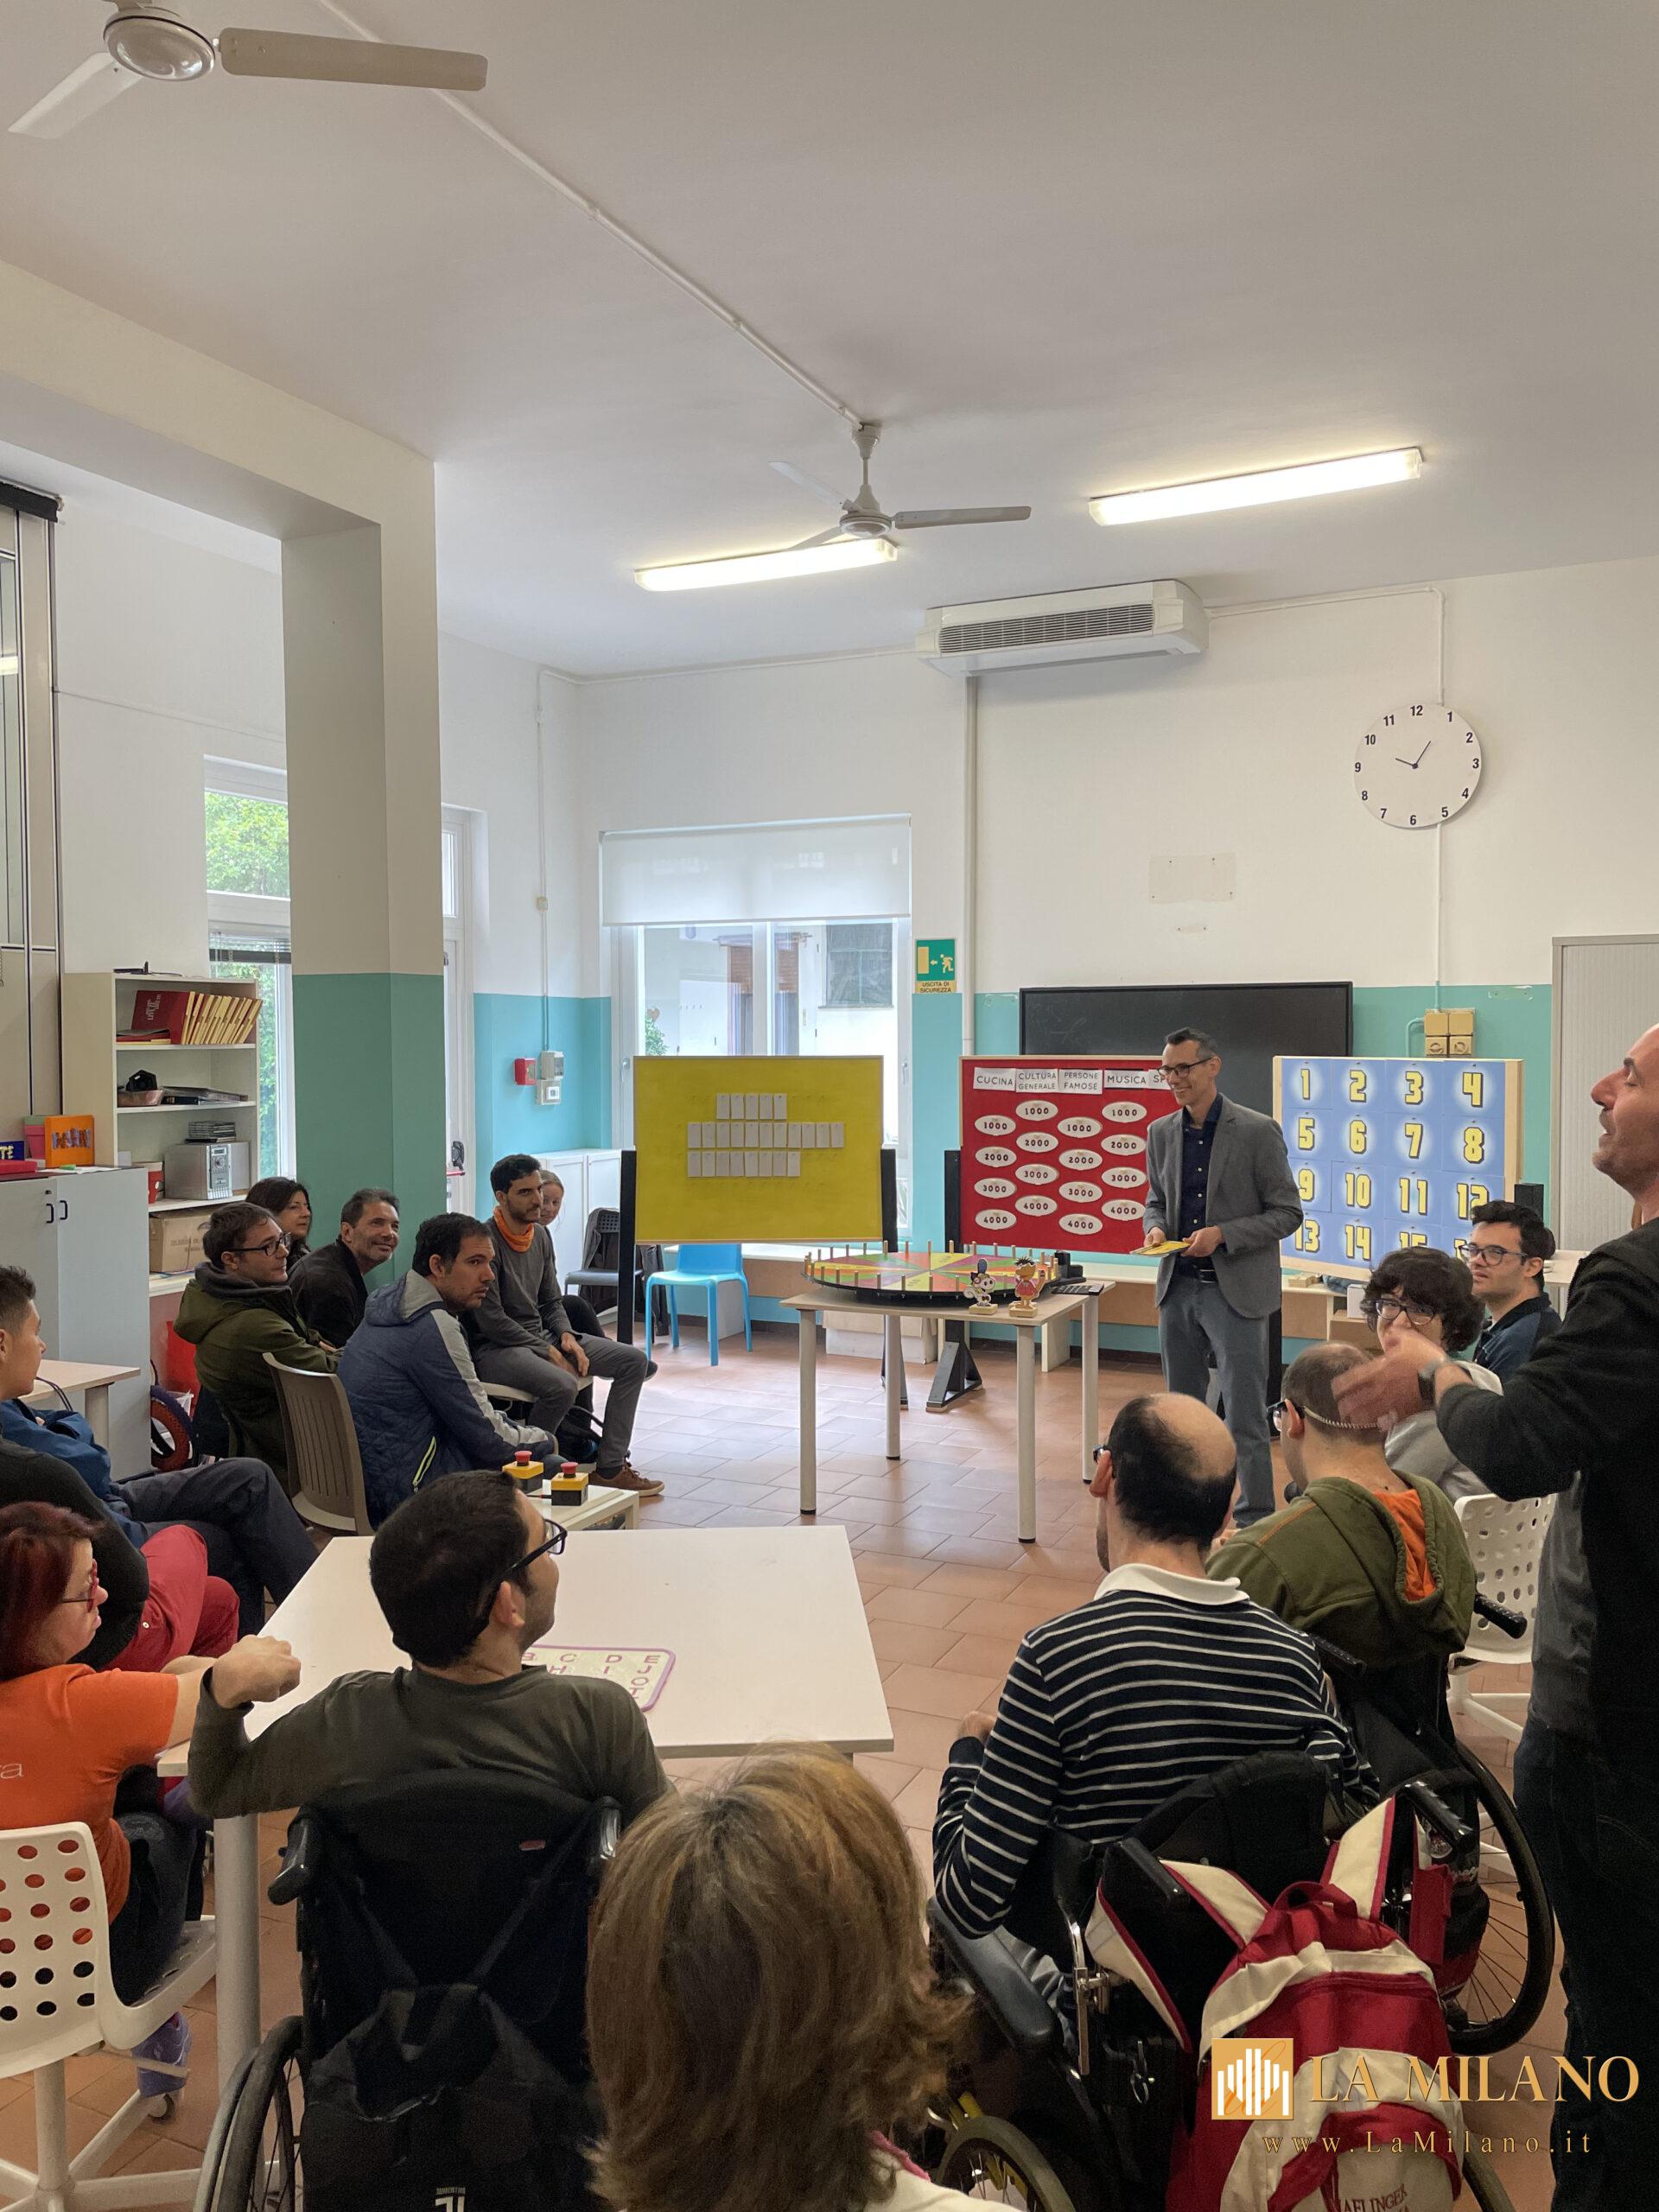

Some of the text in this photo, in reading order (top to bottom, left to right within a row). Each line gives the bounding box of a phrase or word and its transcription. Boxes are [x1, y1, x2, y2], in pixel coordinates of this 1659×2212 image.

[1410, 705, 1423, 716] 12
[1383, 715, 1395, 726] 11
[1447, 711, 1452, 722] 1
[1364, 734, 1376, 745] 10
[1466, 732, 1473, 743] 2
[1355, 762, 1361, 772] 9
[1472, 758, 1479, 769] 3
[1362, 791, 1368, 800] 8
[1462, 788, 1469, 799] 4
[1381, 808, 1387, 818] 7
[1441, 806, 1448, 817] 5
[1410, 815, 1416, 825] 6
[976, 1076, 1013, 1086] CUCINA
[1107, 1075, 1147, 1084] MUSICA
[1064, 1082, 1097, 1090] FAMOSE
[1300, 1068, 1483, 1108] 1 2 3 4
[983, 1122, 1007, 1130] 1000
[1111, 1141, 1136, 1149] 2000
[1298, 1116, 1484, 1164] 5 6 7 8
[1024, 1170, 1048, 1179] 3000
[982, 1185, 1007, 1193] 3000
[1068, 1188, 1093, 1197] 3000
[1298, 1168, 1489, 1220] 9 10 11 12
[1110, 1206, 1136, 1215] 4000
[1068, 1220, 1093, 1229] 4000
[1295, 1219, 1320, 1253] 13
[1344, 1224, 1371, 1260] 14
[560, 1653, 577, 1662] C
[605, 1655, 622, 1663] D
[644, 1655, 660, 1663] E
[549, 1665, 567, 1675] H
[637, 1665, 652, 1674] J
[631, 1677, 649, 1686] O
